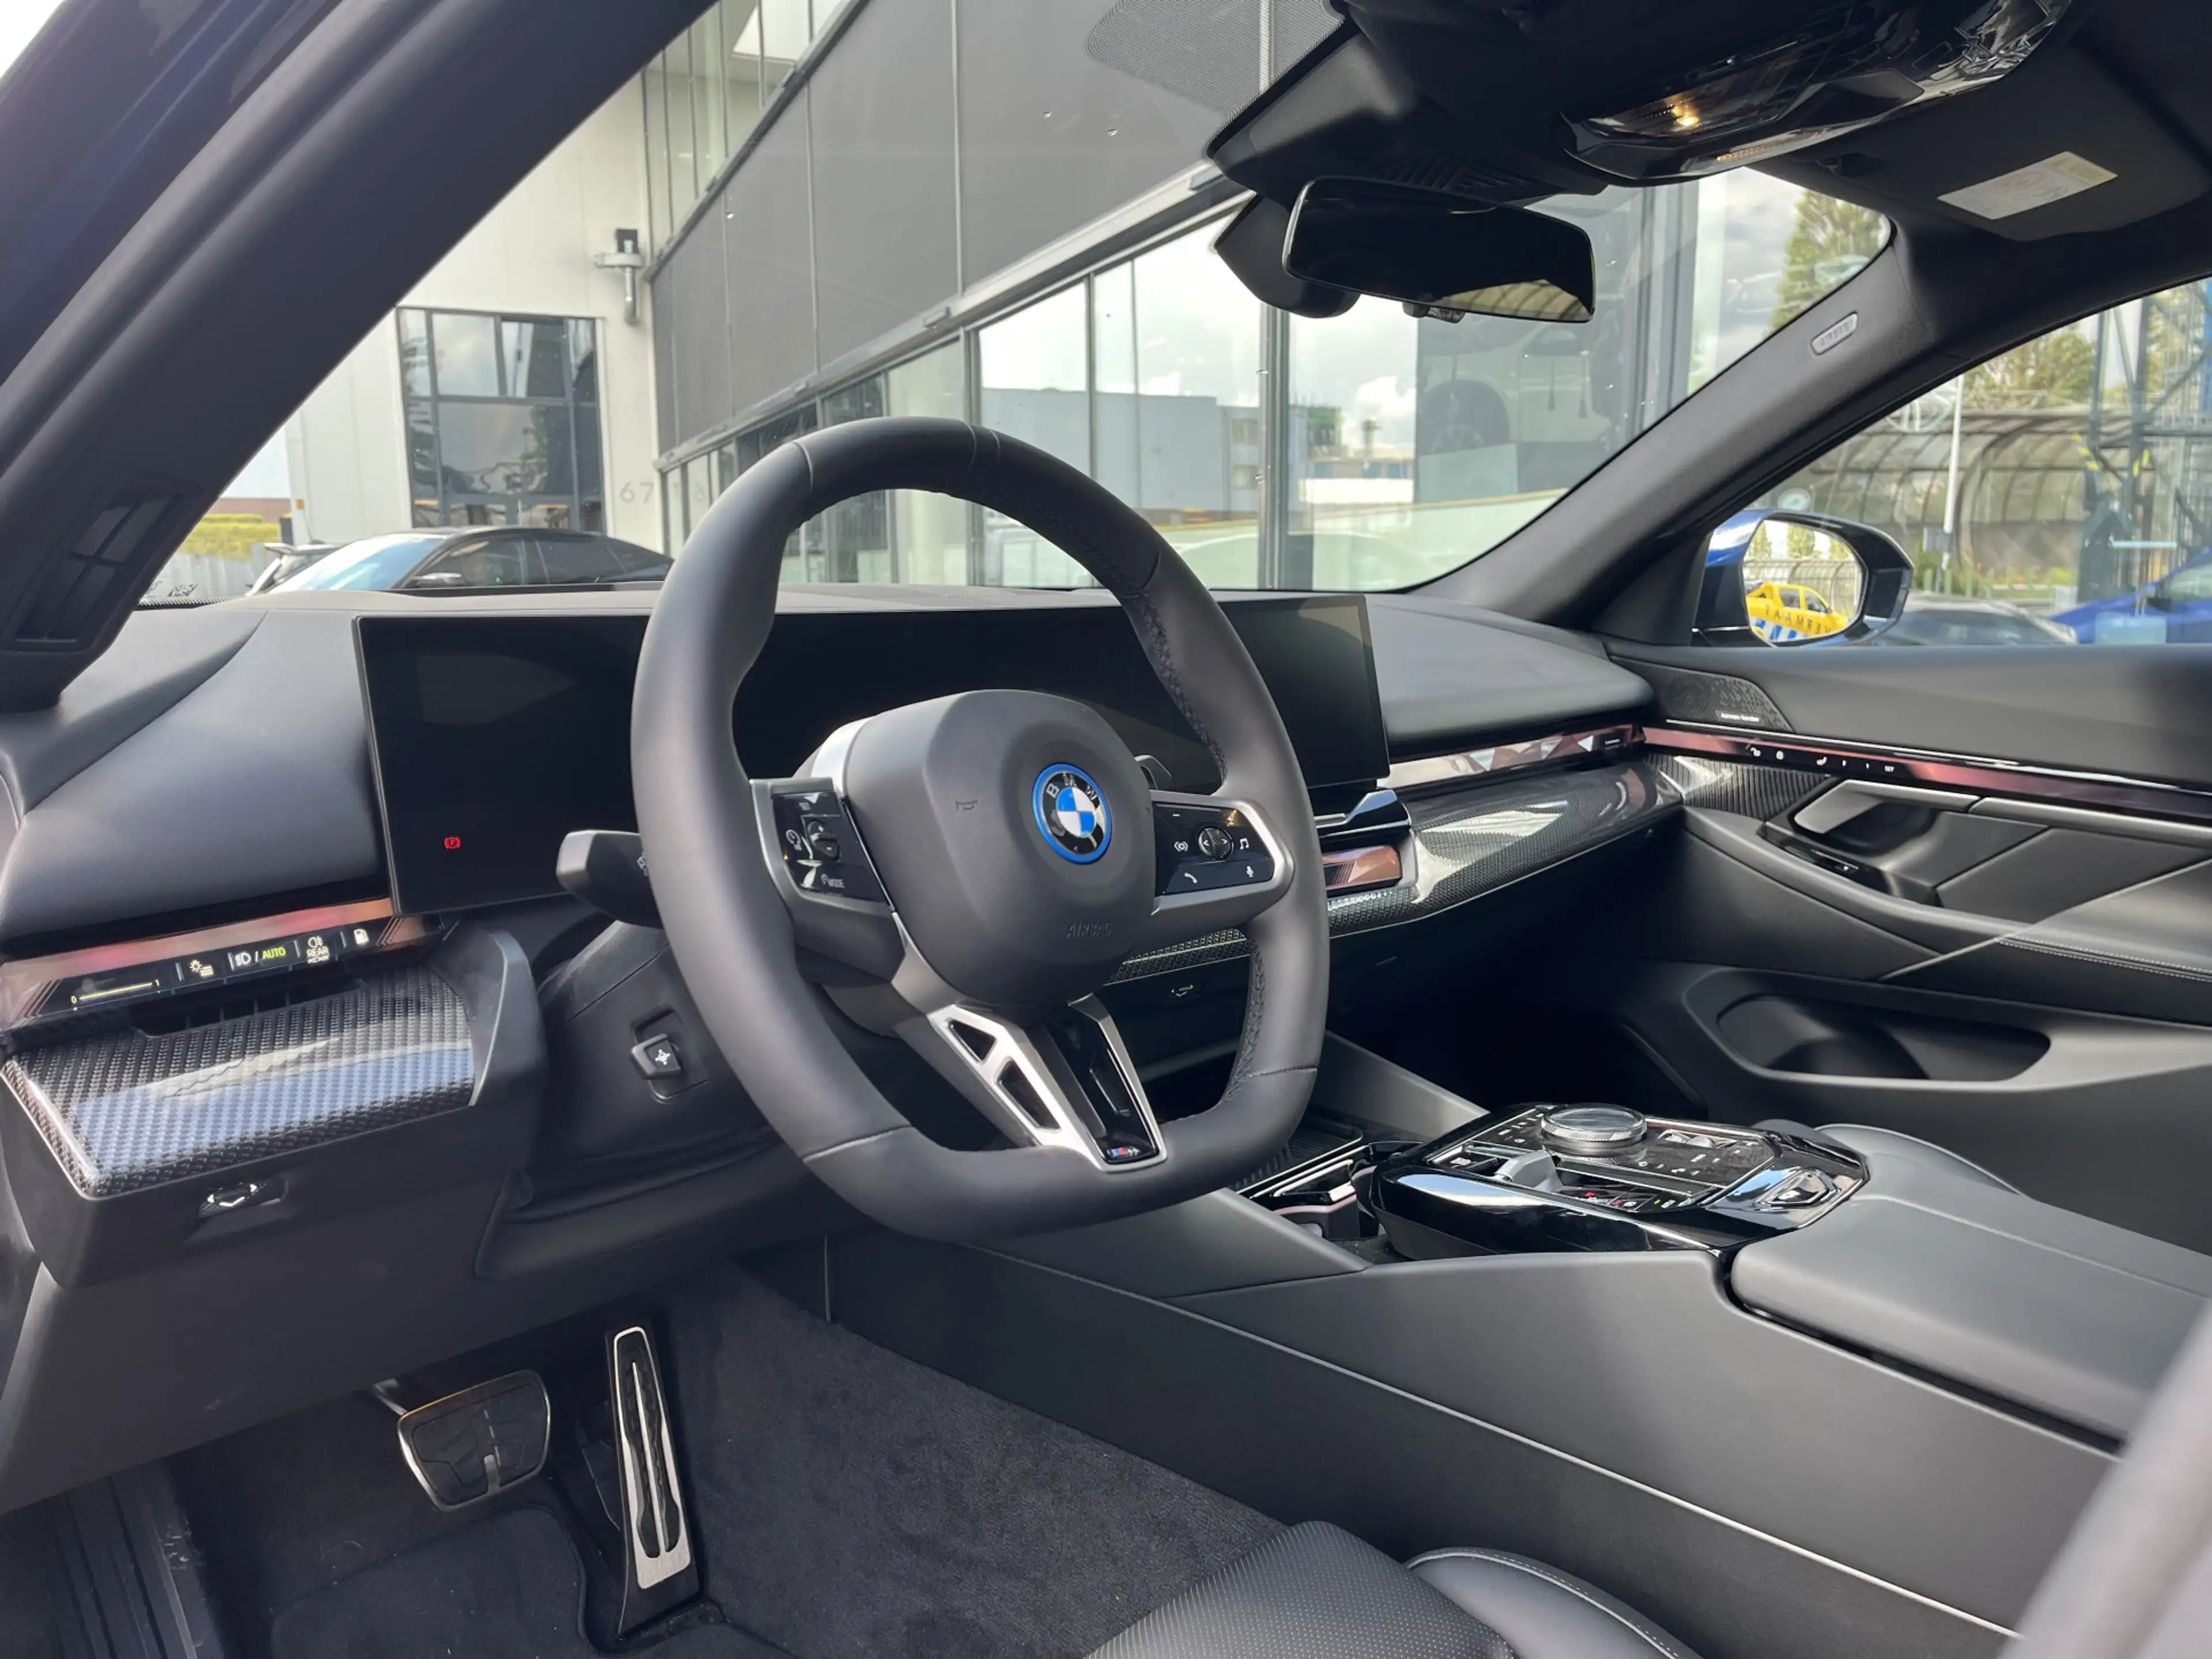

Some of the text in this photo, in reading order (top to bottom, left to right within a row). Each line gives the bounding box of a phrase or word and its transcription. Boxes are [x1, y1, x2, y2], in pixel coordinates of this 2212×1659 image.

[619, 480, 655, 504] 67
[1046, 771, 1098, 800] BMW
[262, 946, 287, 960] AUTO
[306, 946, 330, 958] REAR
